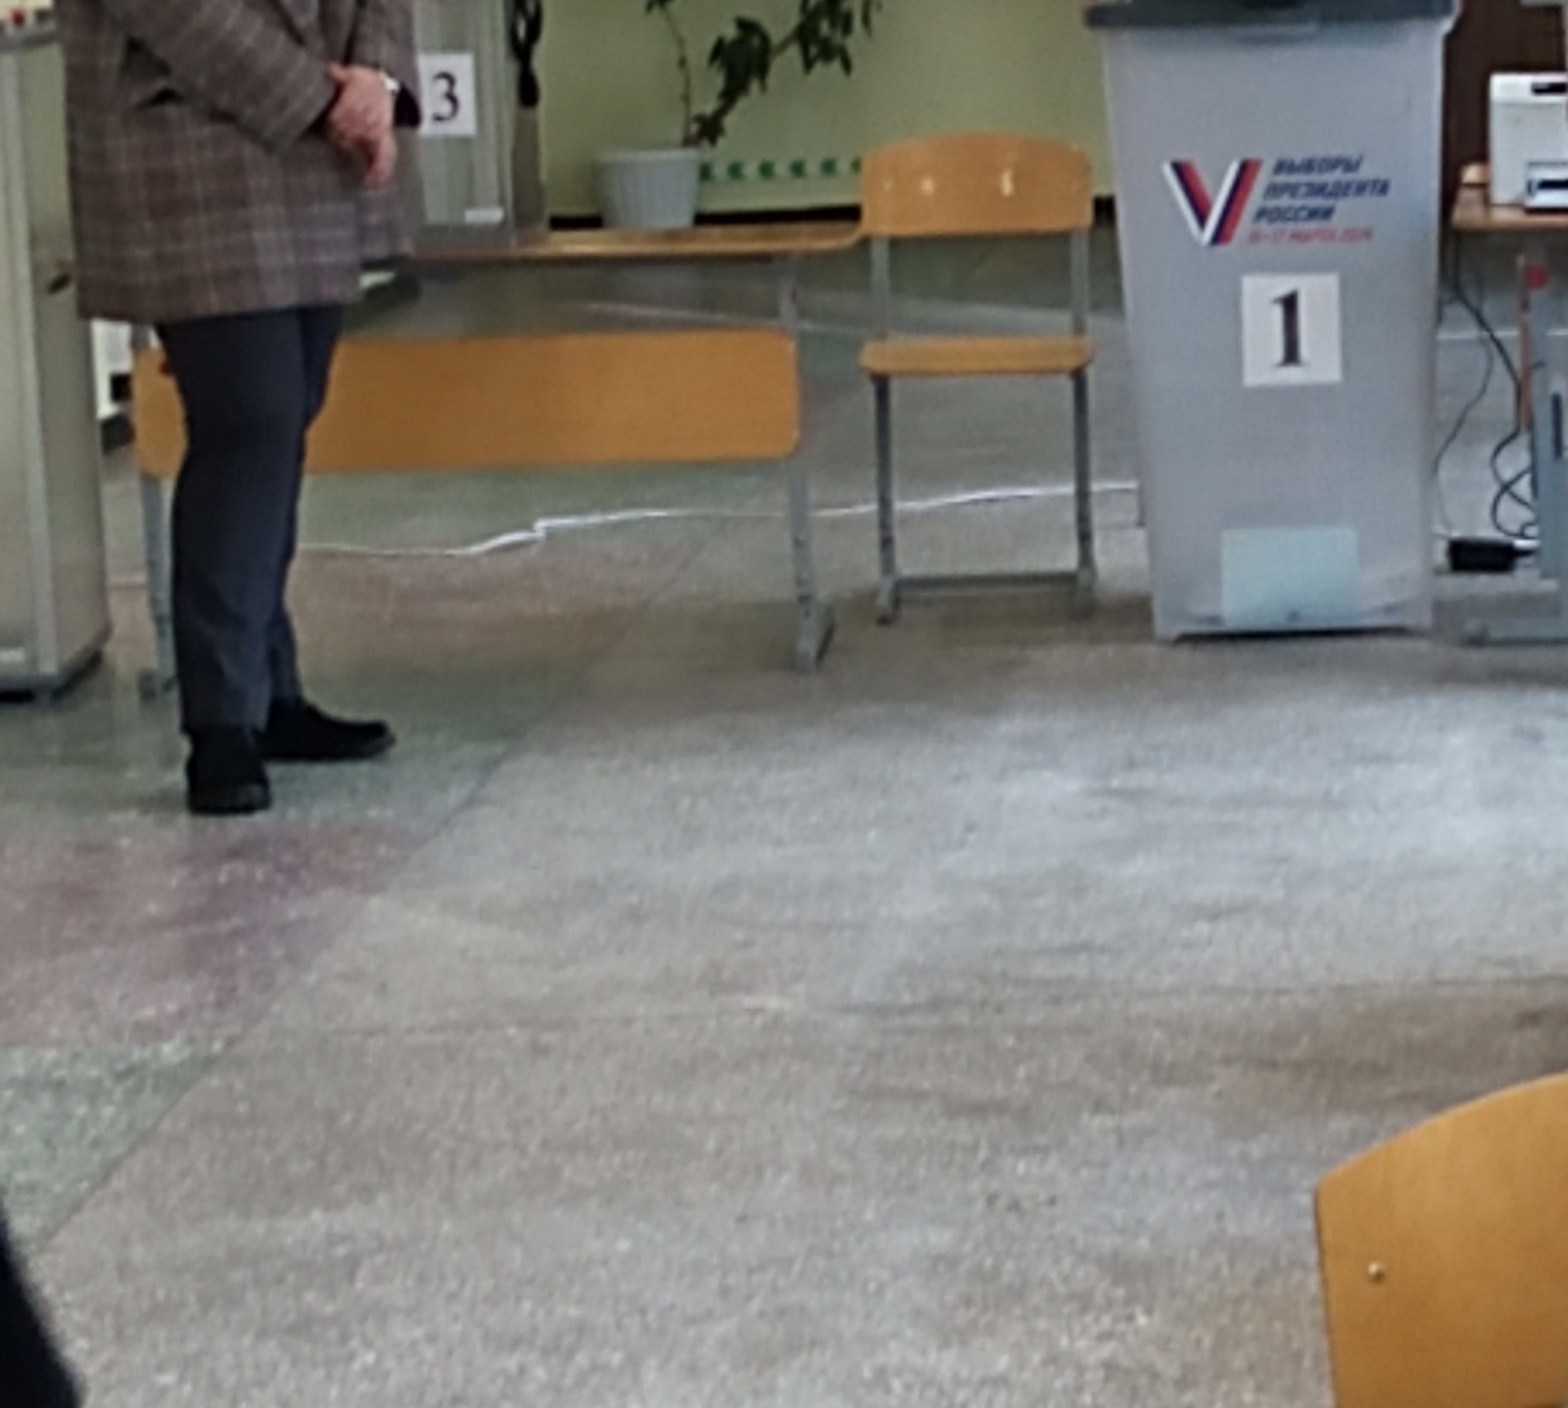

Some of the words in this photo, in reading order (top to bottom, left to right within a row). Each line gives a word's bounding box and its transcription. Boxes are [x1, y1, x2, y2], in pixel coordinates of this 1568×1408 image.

[432, 71, 460, 123] 3
[1273, 155, 1363, 176] ВЫБОРЫ
[1263, 179, 1390, 201] ПРЕЗИДЕНТА
[1253, 205, 1336, 224] РОССИИ
[1270, 288, 1308, 369] 1
